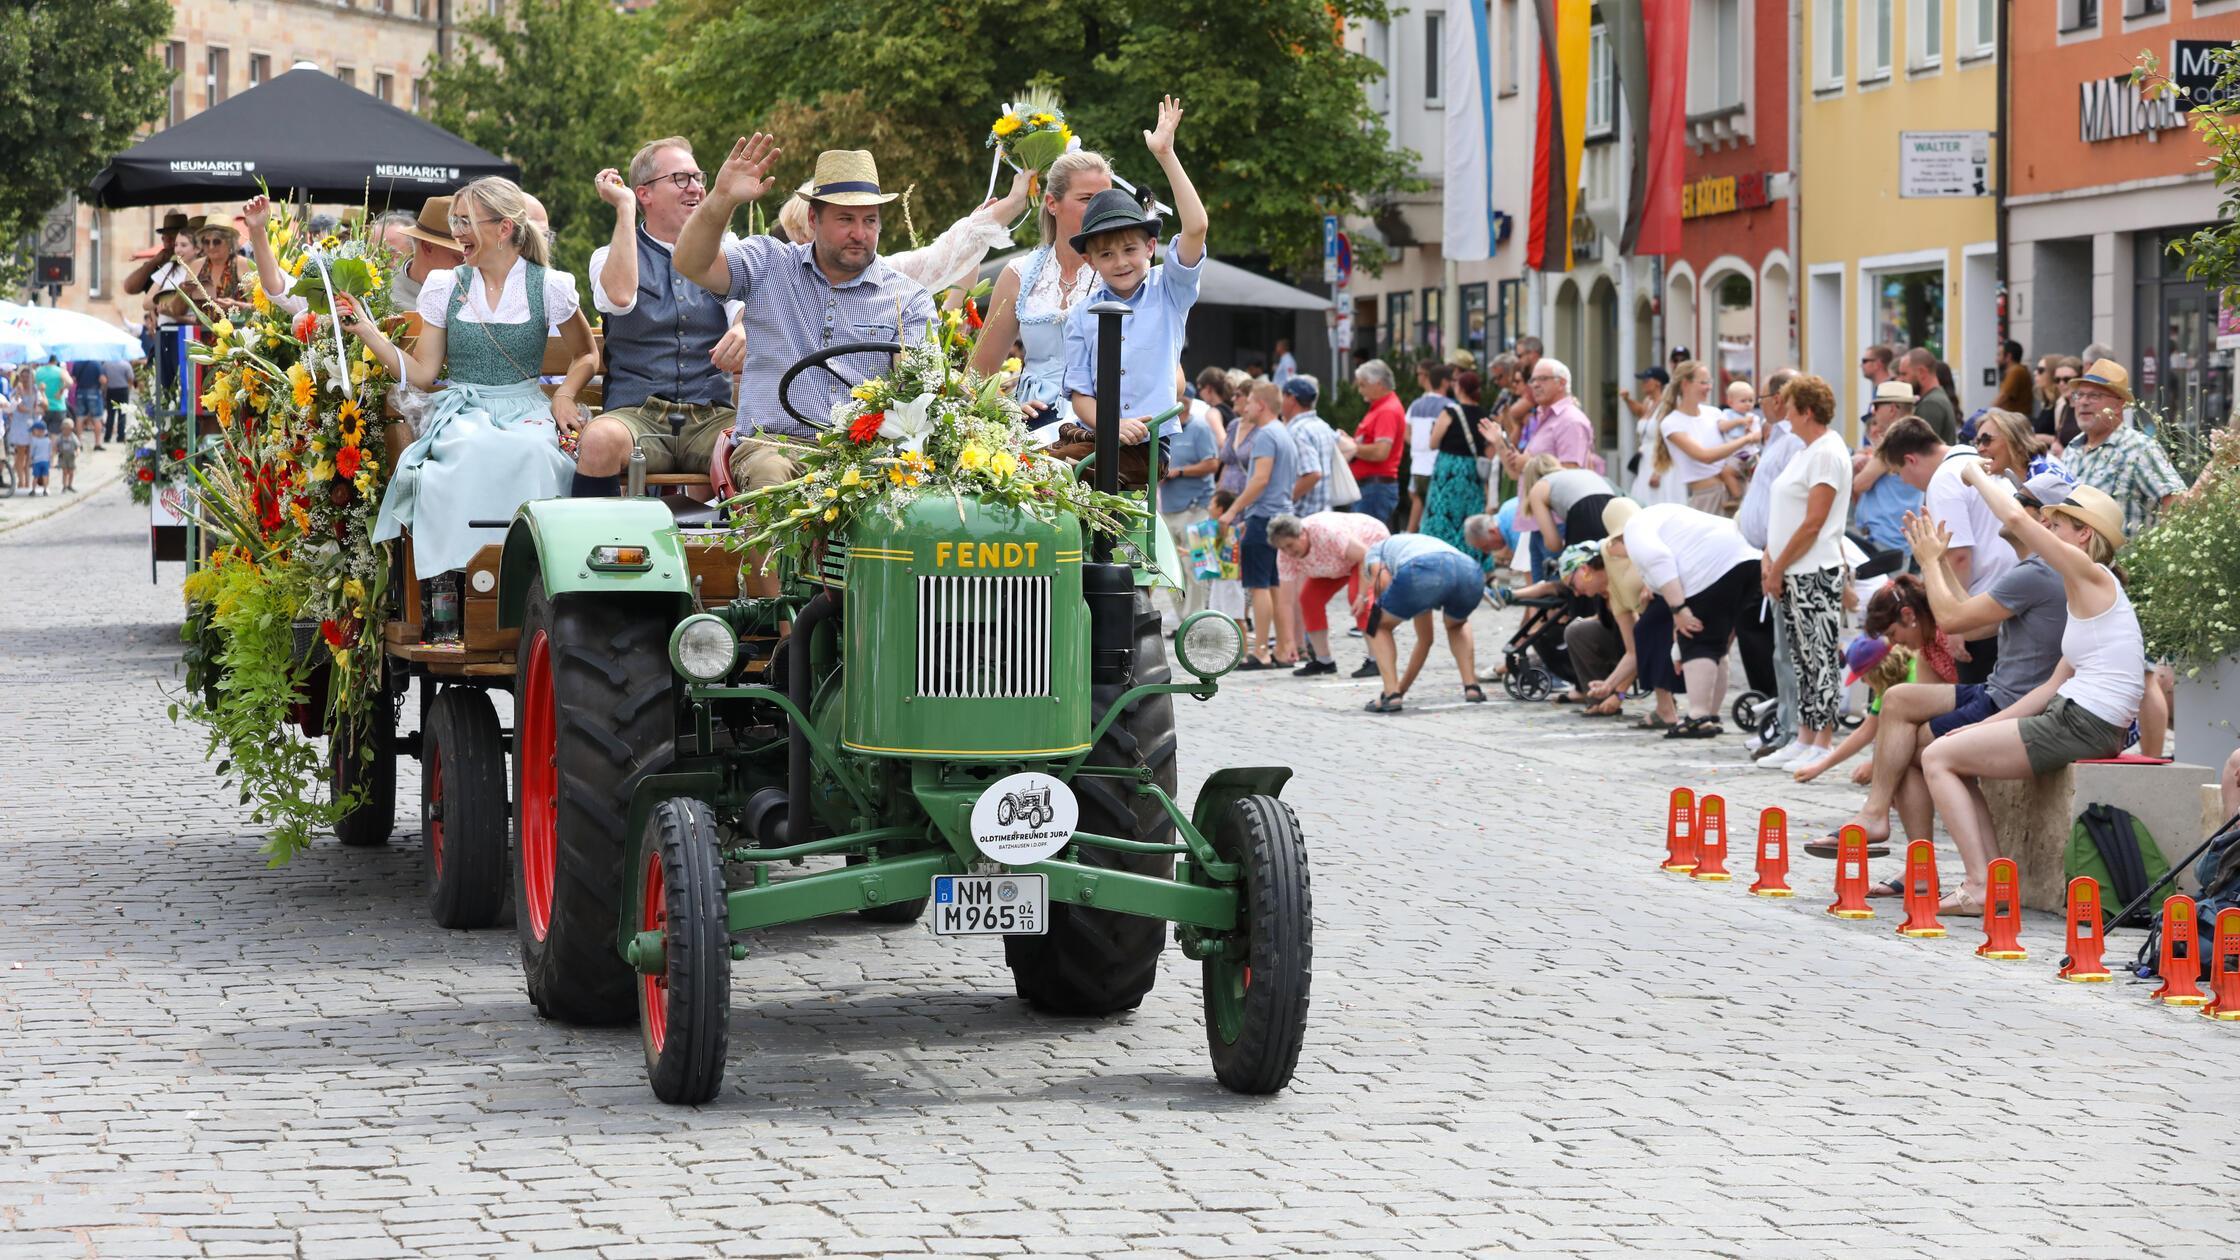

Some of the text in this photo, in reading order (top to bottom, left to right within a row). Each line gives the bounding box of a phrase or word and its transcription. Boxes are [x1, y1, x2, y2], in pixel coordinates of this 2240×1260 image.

[1914, 142, 1961, 152] WALTER
[170, 161, 242, 171] NEUMARKT
[376, 165, 446, 178] NEUMARKT
[1695, 174, 1736, 216] BÄCKER
[936, 542, 1039, 568] FENDT
[980, 830, 1069, 843] OLDTIMERFREUNDE JURA
[942, 893, 948, 901] D
[958, 881, 991, 905] NM
[1019, 905, 1034, 915] 04
[1020, 920, 1034, 930] 10
